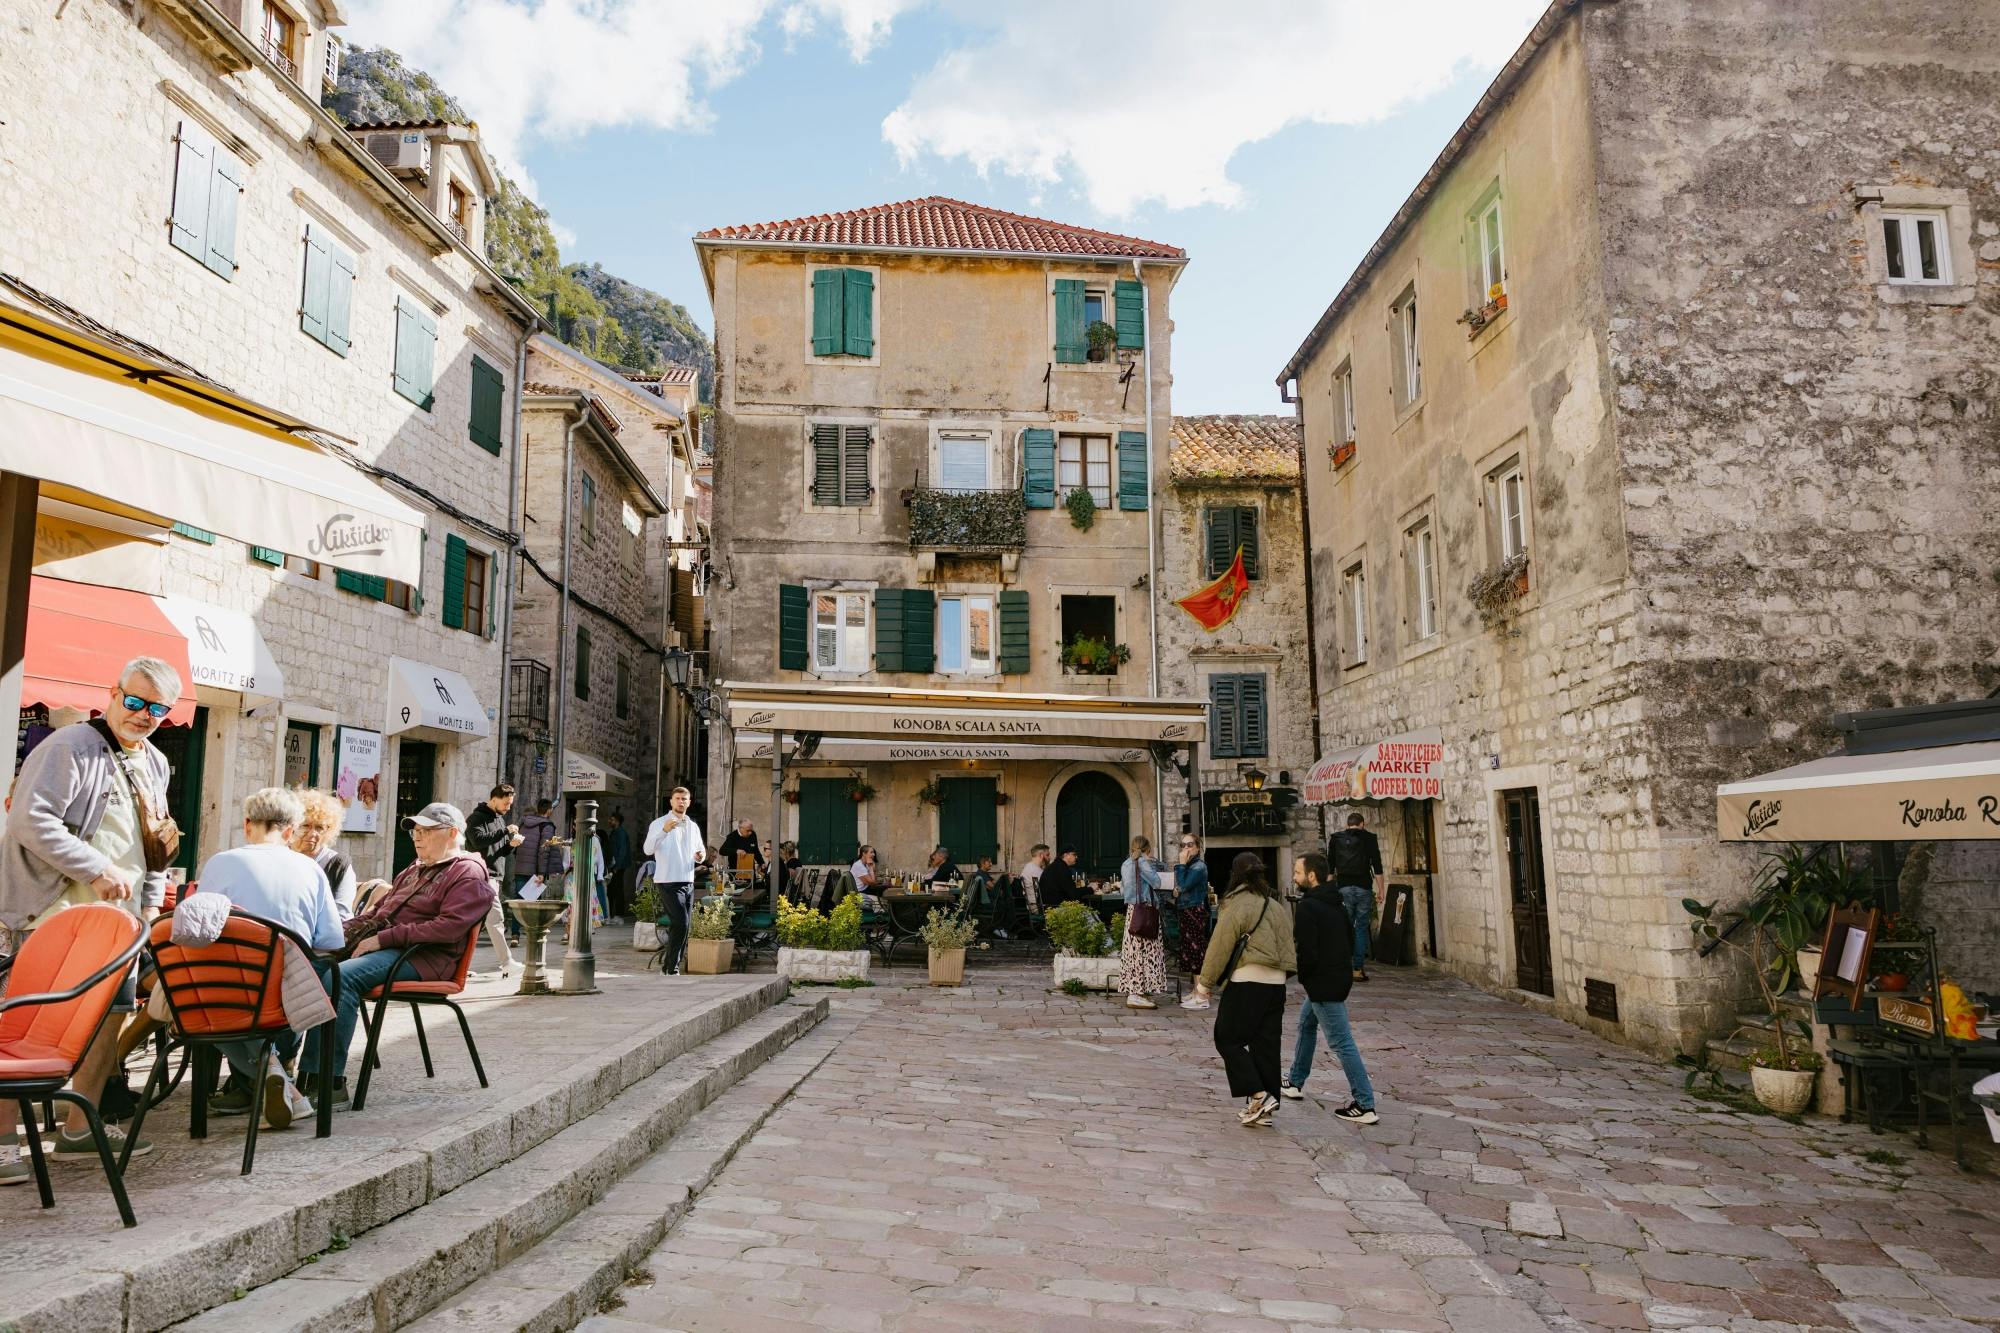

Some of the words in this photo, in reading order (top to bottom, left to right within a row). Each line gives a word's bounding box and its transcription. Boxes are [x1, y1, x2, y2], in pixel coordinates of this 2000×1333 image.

[192, 665, 234, 685] MORITZ
[240, 675, 255, 689] EIS
[438, 716, 463, 729] MORITZ
[464, 720, 475, 731] EIS
[893, 718, 951, 731] KONOBA
[955, 721, 995, 732] SCALA
[1000, 721, 1042, 732] SANTA
[890, 749, 937, 758] KONOBA
[940, 749, 972, 757] SCALA
[975, 749, 1010, 757] SANTA
[1378, 743, 1442, 760] SANDWICHES
[1368, 761, 1430, 774] MARKET
[1371, 778, 1403, 795] COFFEE
[1405, 778, 1422, 795] TO
[1426, 778, 1439, 796] GO
[1899, 799, 1967, 828] Konoba
[1886, 1001, 1928, 1028] Roma
